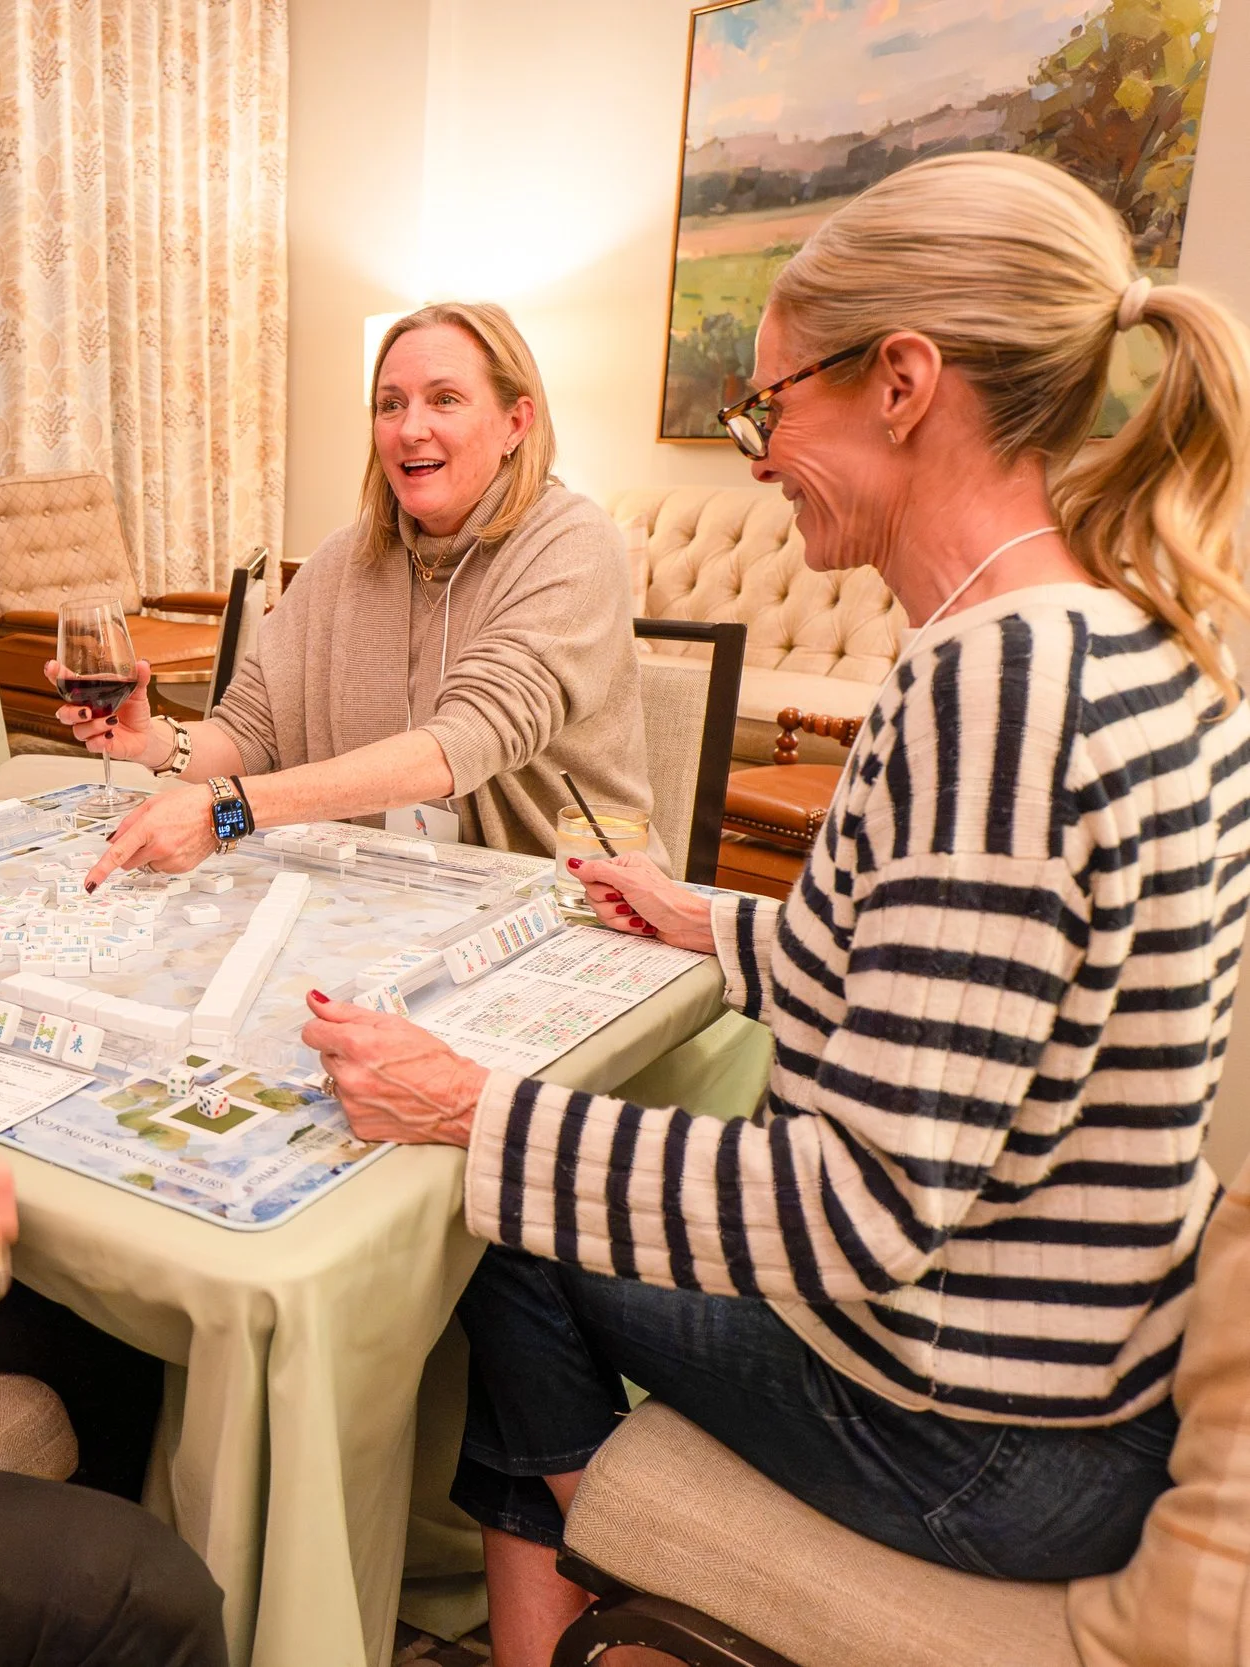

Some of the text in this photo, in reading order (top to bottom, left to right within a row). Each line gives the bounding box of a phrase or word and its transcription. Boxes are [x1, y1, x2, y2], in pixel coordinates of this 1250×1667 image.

[218, 824, 231, 834] 6:11
[33, 1114, 227, 1191] NO JOKERS IN SINGLES OR PAIRS
[247, 1143, 317, 1187] CHARLESTON
